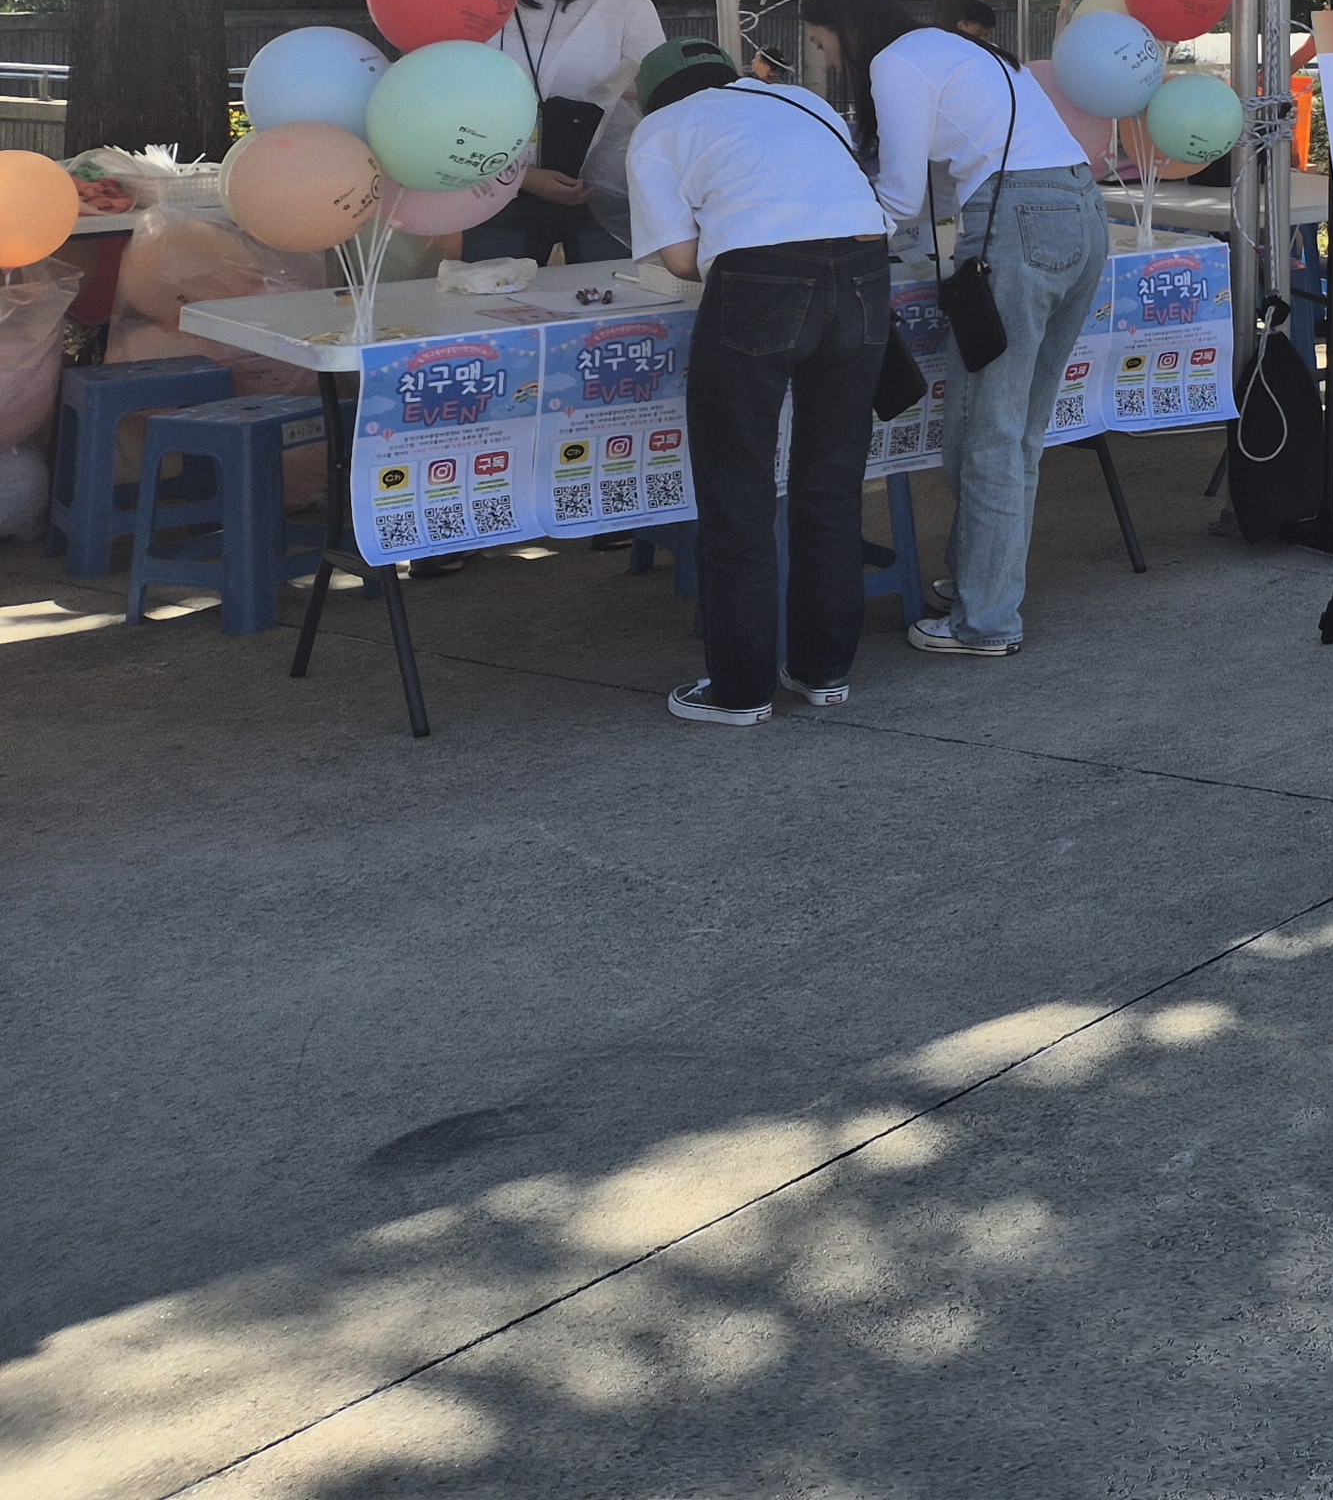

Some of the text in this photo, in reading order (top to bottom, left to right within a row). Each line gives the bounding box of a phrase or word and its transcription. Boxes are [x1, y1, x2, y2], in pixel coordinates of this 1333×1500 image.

[1139, 268, 1208, 305] 친구맺기
[1143, 297, 1200, 325] EVENT
[578, 339, 675, 380] 친구맺기
[399, 359, 507, 404] 친구맺기
[584, 371, 663, 404] EVENT
[403, 393, 491, 426] EVENT
[651, 432, 680, 450] 구독
[478, 454, 507, 471] 구독
